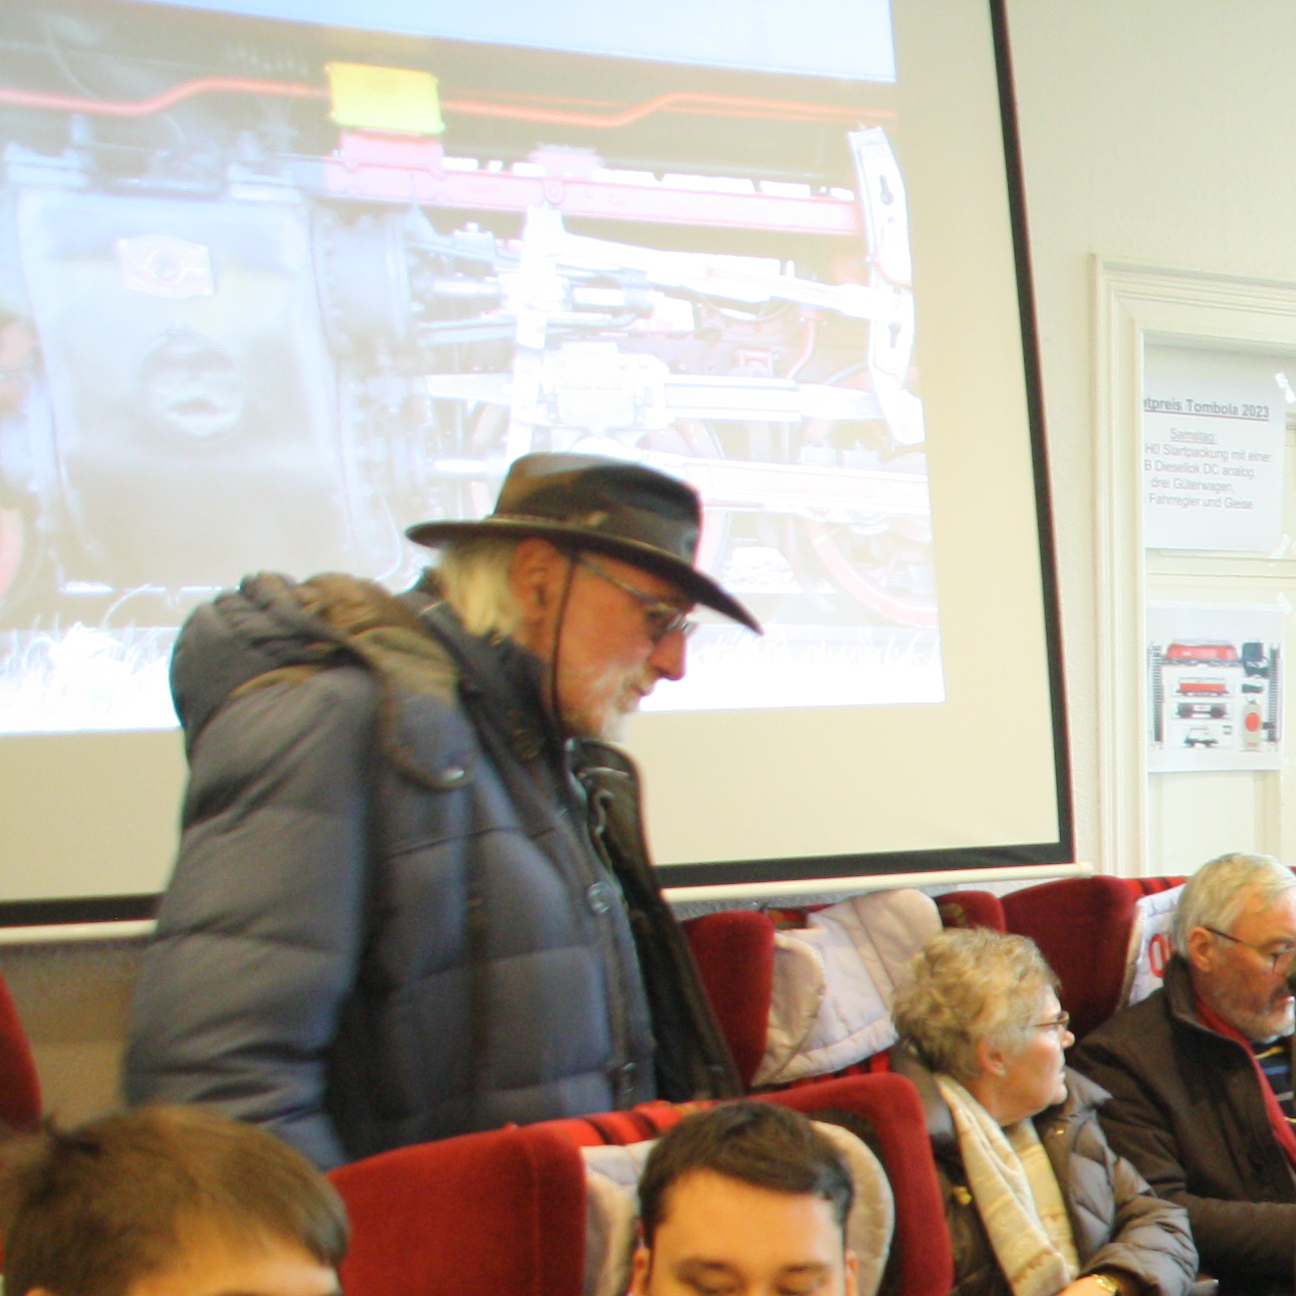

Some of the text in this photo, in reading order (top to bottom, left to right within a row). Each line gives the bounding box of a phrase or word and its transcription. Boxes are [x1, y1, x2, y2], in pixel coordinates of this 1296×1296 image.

[1186, 399, 1239, 416] Tombola
[1242, 404, 1270, 418] 2023
[1163, 444, 1229, 462] Startpackung
[1231, 450, 1247, 460] mit
[1248, 452, 1272, 463] einer
[1156, 460, 1201, 473] Diesellok
[1203, 463, 1220, 475] DC
[1204, 497, 1222, 508] und
